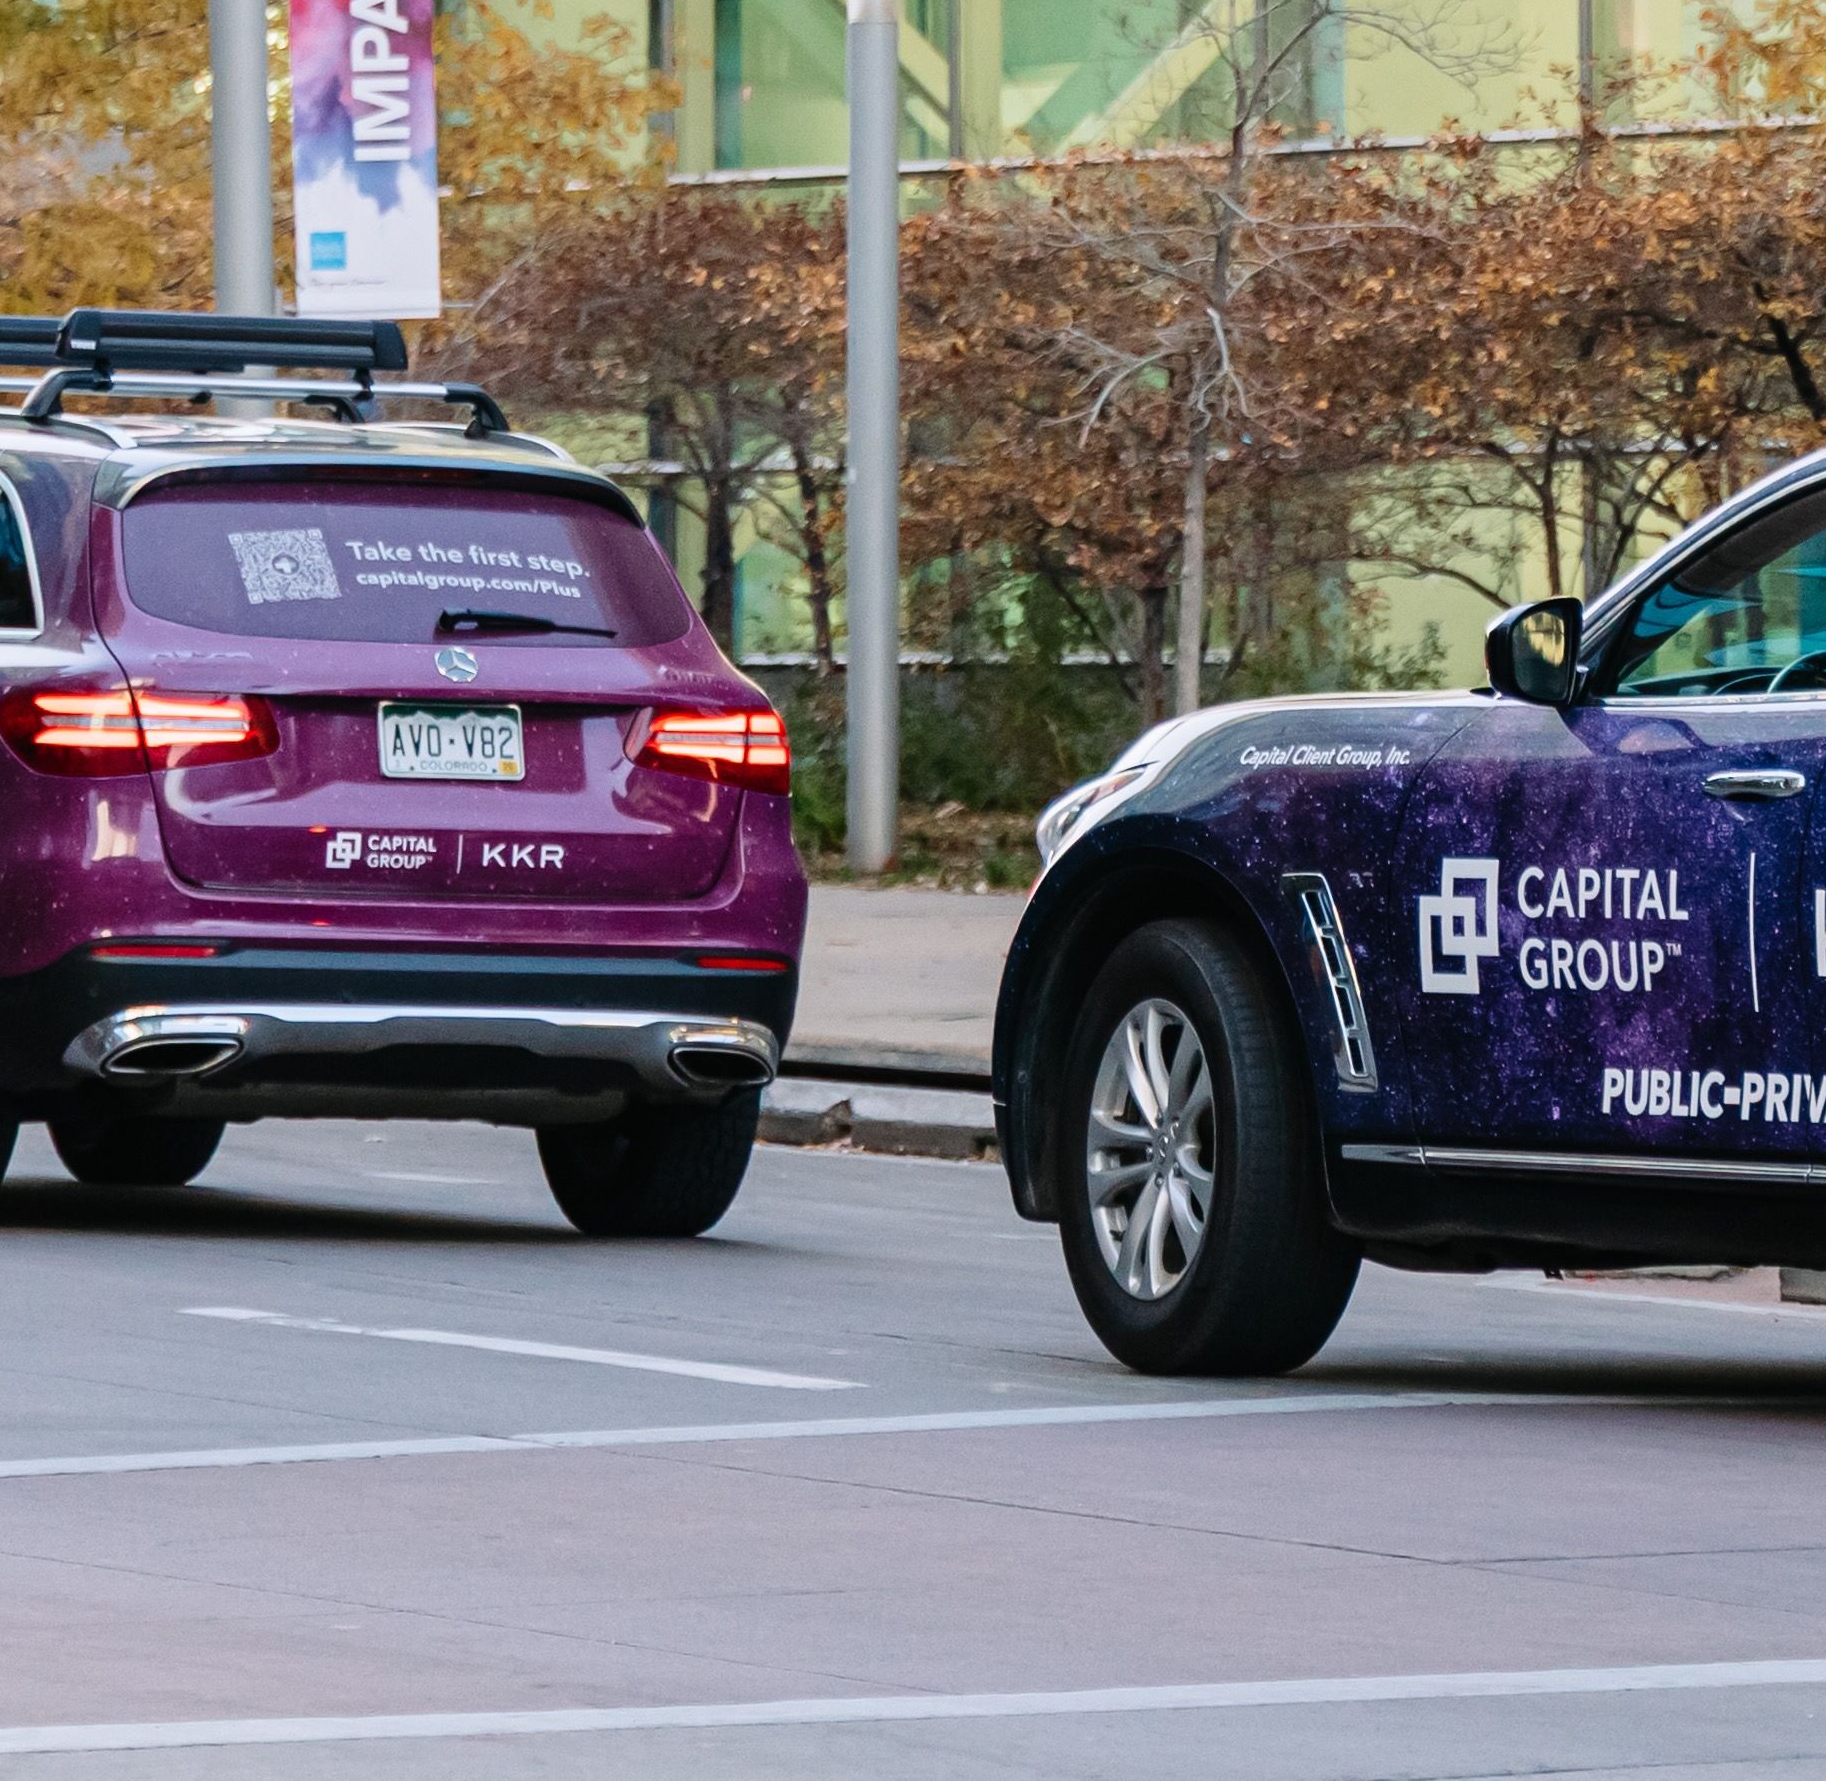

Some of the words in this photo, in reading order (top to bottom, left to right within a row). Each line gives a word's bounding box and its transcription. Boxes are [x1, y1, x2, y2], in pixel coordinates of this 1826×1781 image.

[345, 540, 412, 562] Take
[418, 542, 464, 564] the
[469, 545, 522, 569] first
[527, 553, 590, 578] step.
[356, 570, 581, 599] capitalgroup.com/Plus
[420, 760, 488, 772] COLORADO
[1240, 744, 1295, 769] Capital
[1292, 745, 1336, 765] Client
[1336, 744, 1382, 770] Group,
[1385, 746, 1410, 765] Inc.
[367, 835, 437, 852] CAPITAL
[483, 843, 565, 869] KKR
[1517, 866, 1690, 921] CAPITAL
